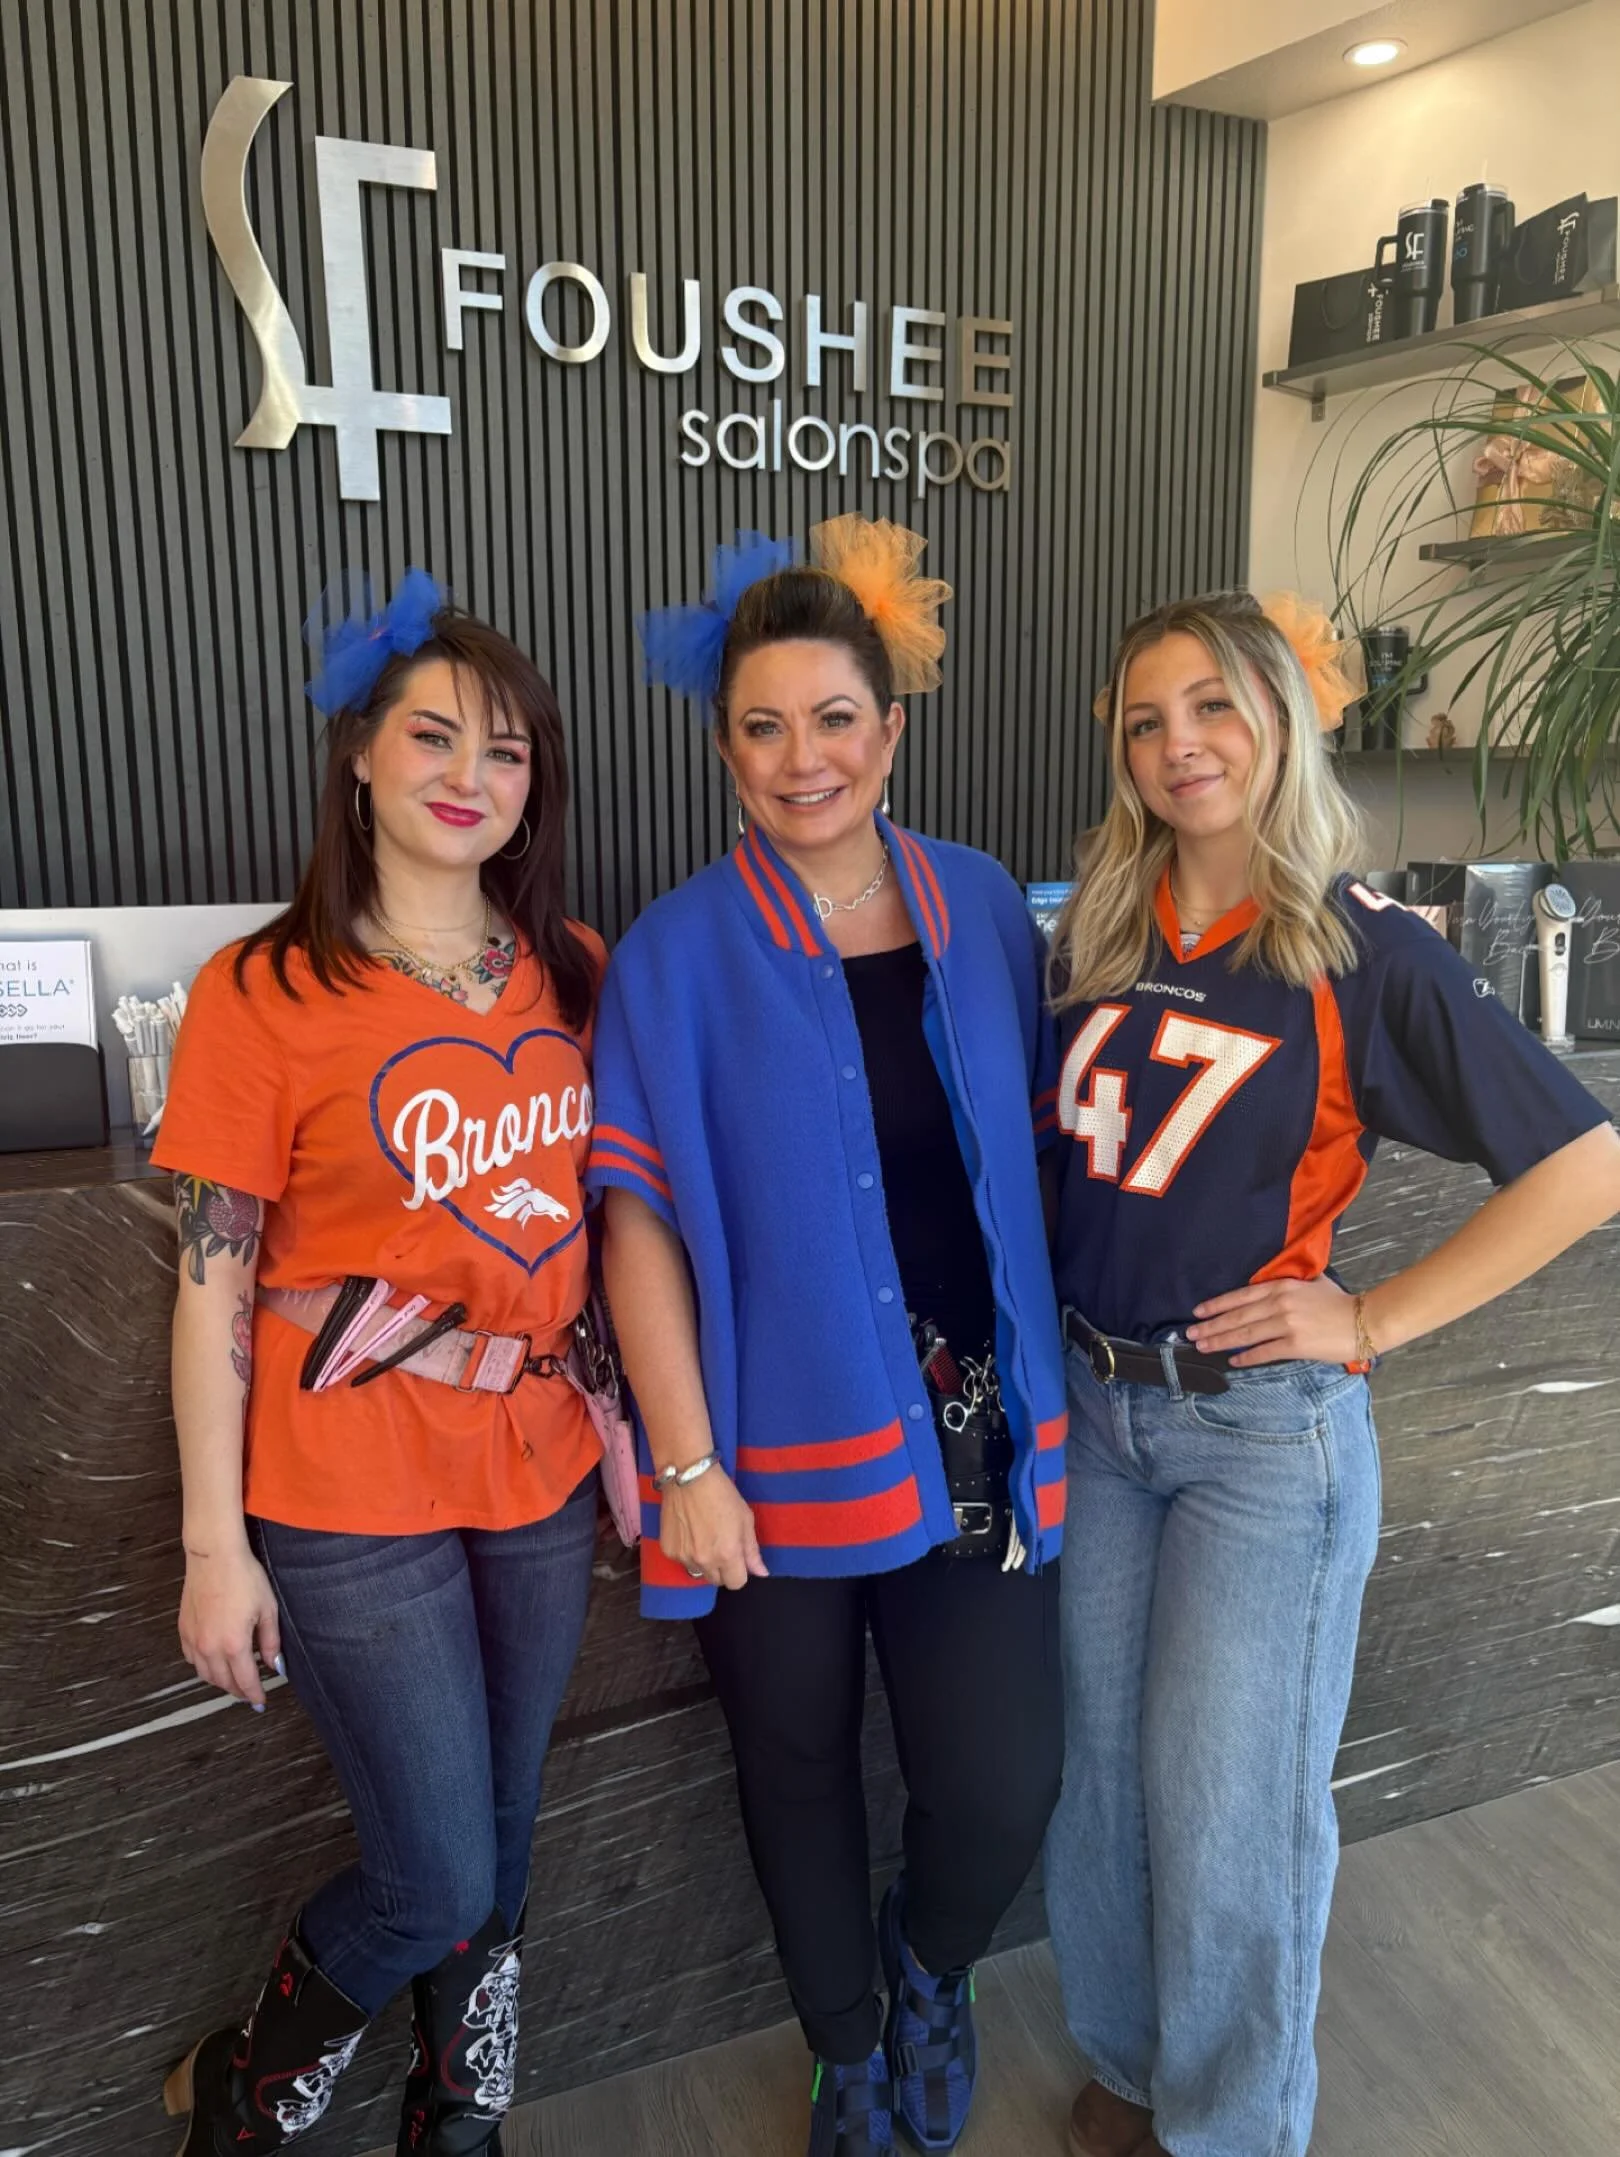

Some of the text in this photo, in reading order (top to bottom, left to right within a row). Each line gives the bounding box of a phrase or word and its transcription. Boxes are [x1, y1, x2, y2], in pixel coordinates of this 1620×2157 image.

[441, 247, 1015, 407] FOUSHEE
[680, 398, 1012, 500] salonspa
[28, 960, 37, 971] is
[1135, 982, 1207, 1003] BRONCOS
[1058, 1003, 1284, 1198] 47
